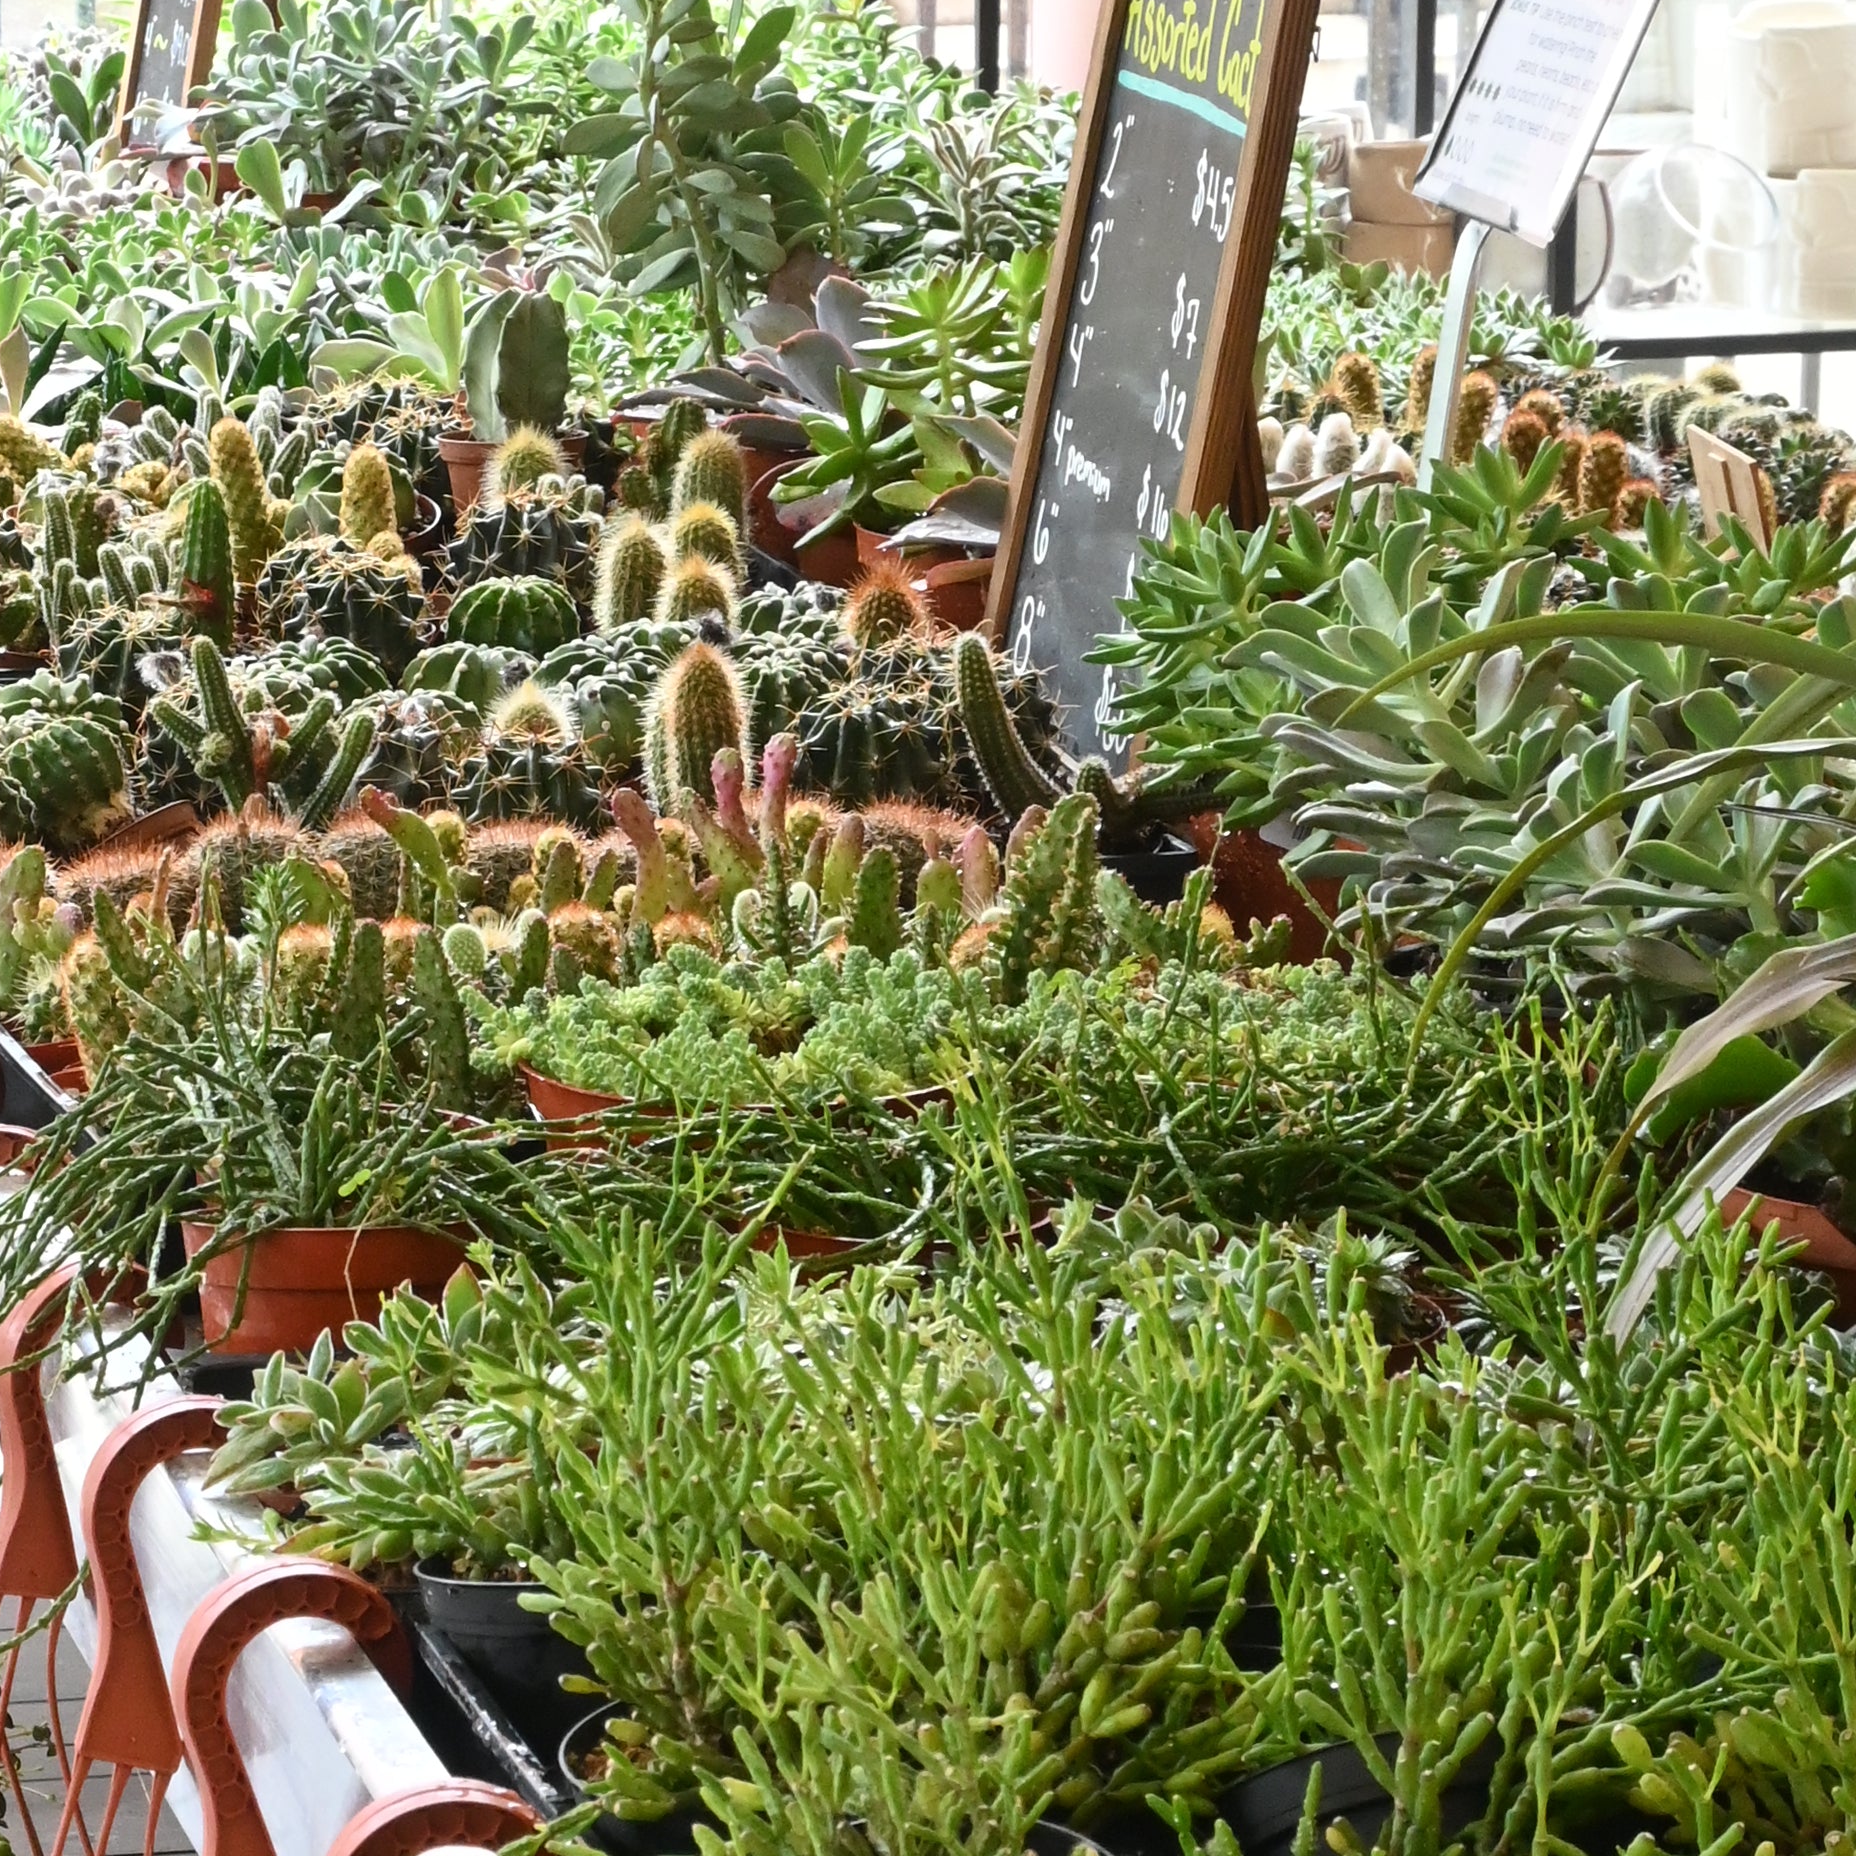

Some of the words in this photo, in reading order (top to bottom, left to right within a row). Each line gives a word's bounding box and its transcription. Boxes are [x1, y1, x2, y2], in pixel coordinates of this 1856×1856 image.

[1100, 115, 1135, 198] 2"
[1191, 147, 1237, 243] $4.5
[1080, 219, 1114, 305] 3"
[1171, 272, 1200, 360] $7
[1070, 323, 1094, 388] 4"
[1153, 368, 1187, 451] $12
[1033, 498, 1060, 565] 6"
[1053, 409, 1074, 466] 4"
[1137, 463, 1169, 542] $16
[1013, 595, 1046, 676] 8"
